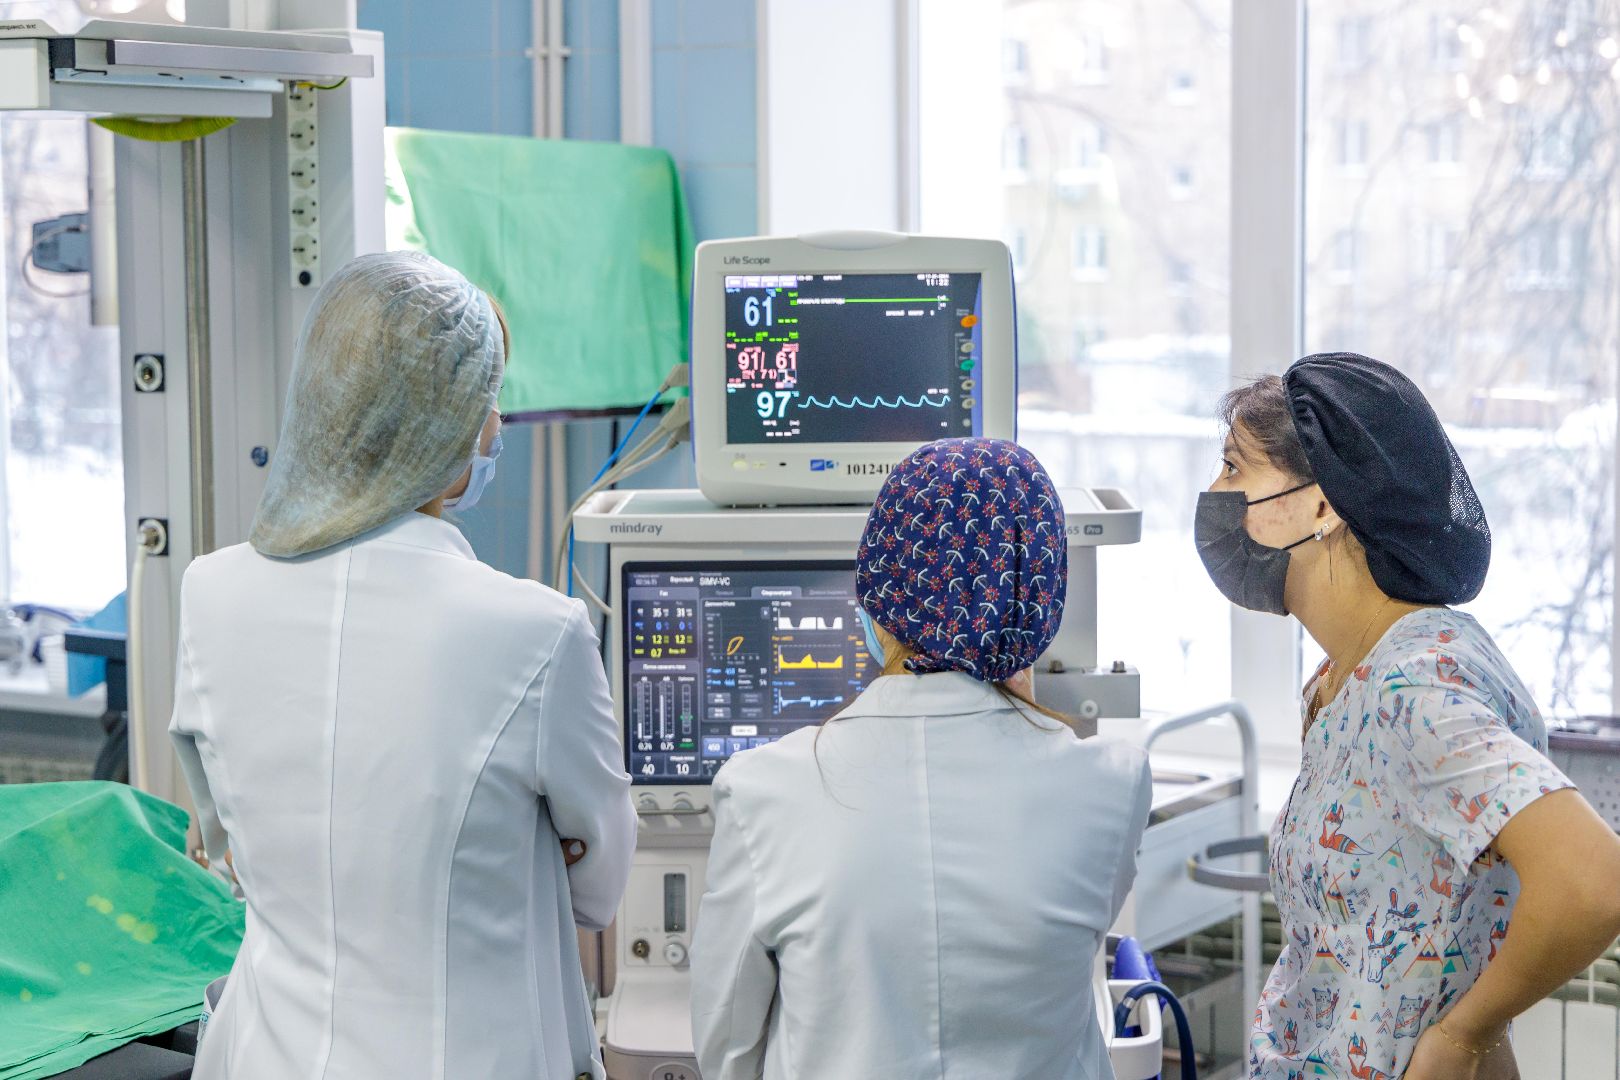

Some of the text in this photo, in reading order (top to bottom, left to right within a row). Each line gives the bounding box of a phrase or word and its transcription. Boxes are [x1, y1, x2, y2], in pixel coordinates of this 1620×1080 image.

[724, 256, 771, 266] Life Scope
[744, 296, 772, 327] 61
[775, 351, 797, 370] 61
[756, 391, 791, 418] 97
[610, 522, 663, 536] mindray
[642, 763, 655, 776] 40
[1346, 898, 1357, 914] ELIT
[1336, 953, 1351, 967] ELIT
